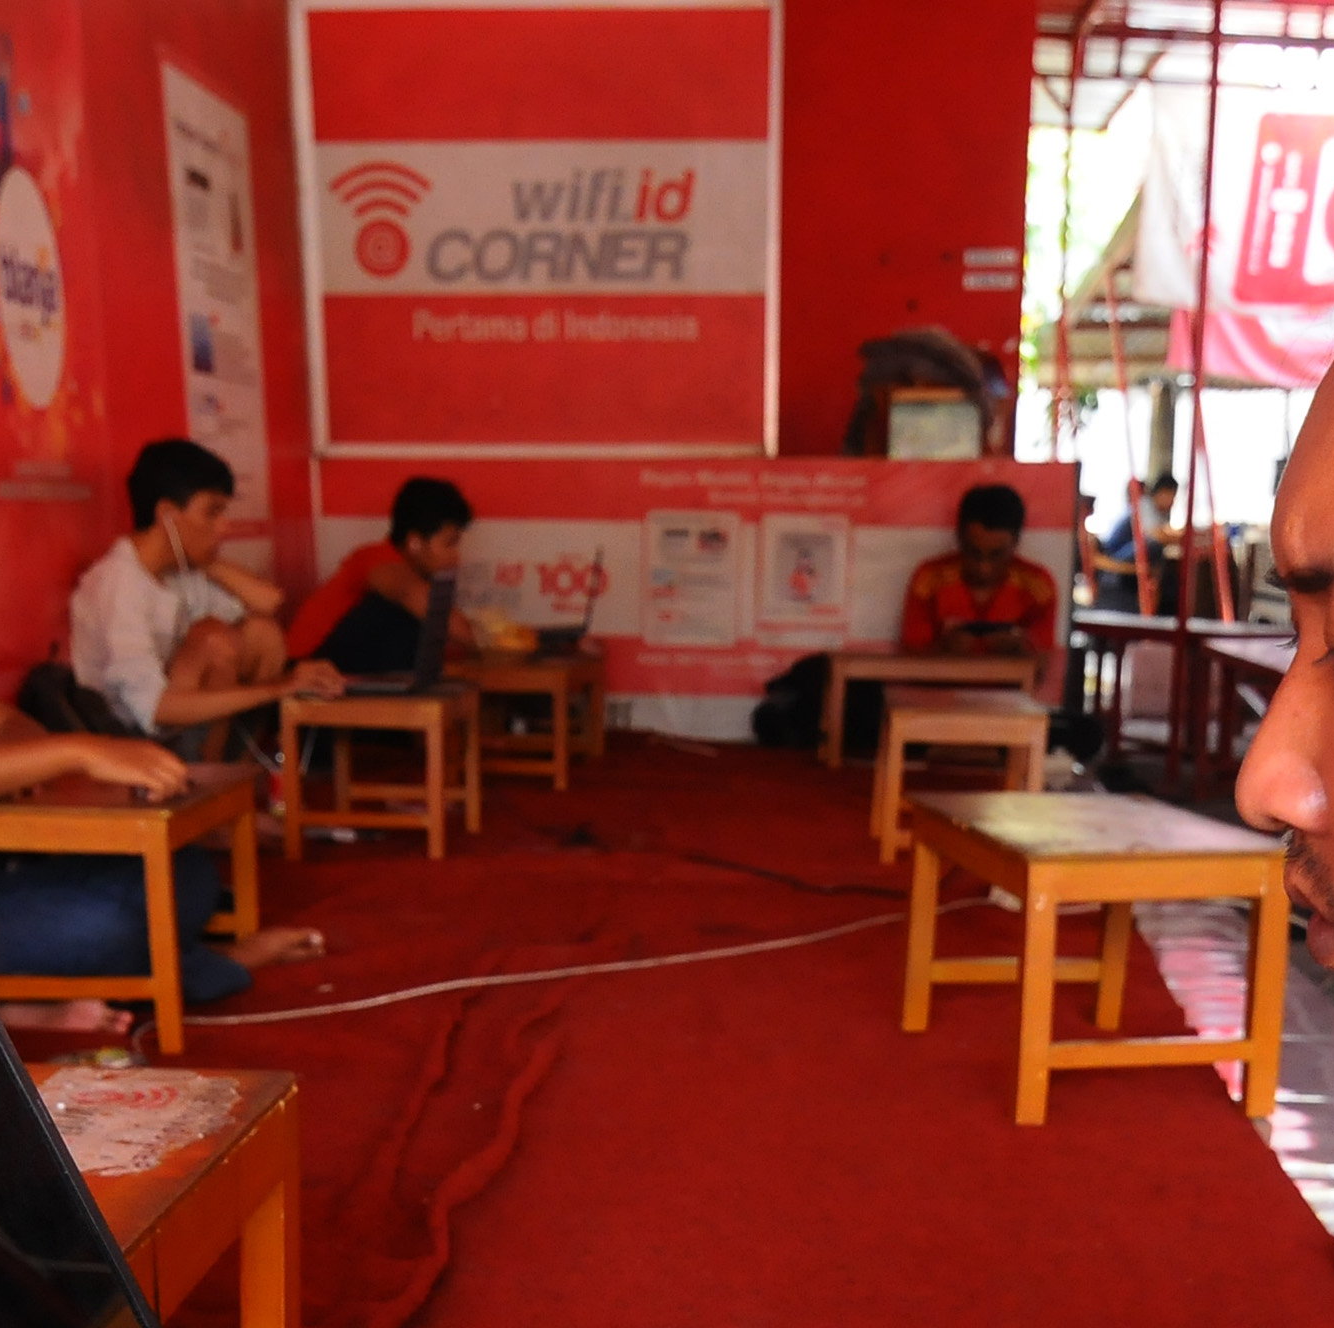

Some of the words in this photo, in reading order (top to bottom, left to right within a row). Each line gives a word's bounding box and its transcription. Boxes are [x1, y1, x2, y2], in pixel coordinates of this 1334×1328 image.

[513, 168, 696, 223] wifi.id
[426, 229, 692, 283] CORNER
[412, 309, 528, 341] Pertama
[532, 309, 560, 341] di
[563, 310, 700, 342] Indonesia
